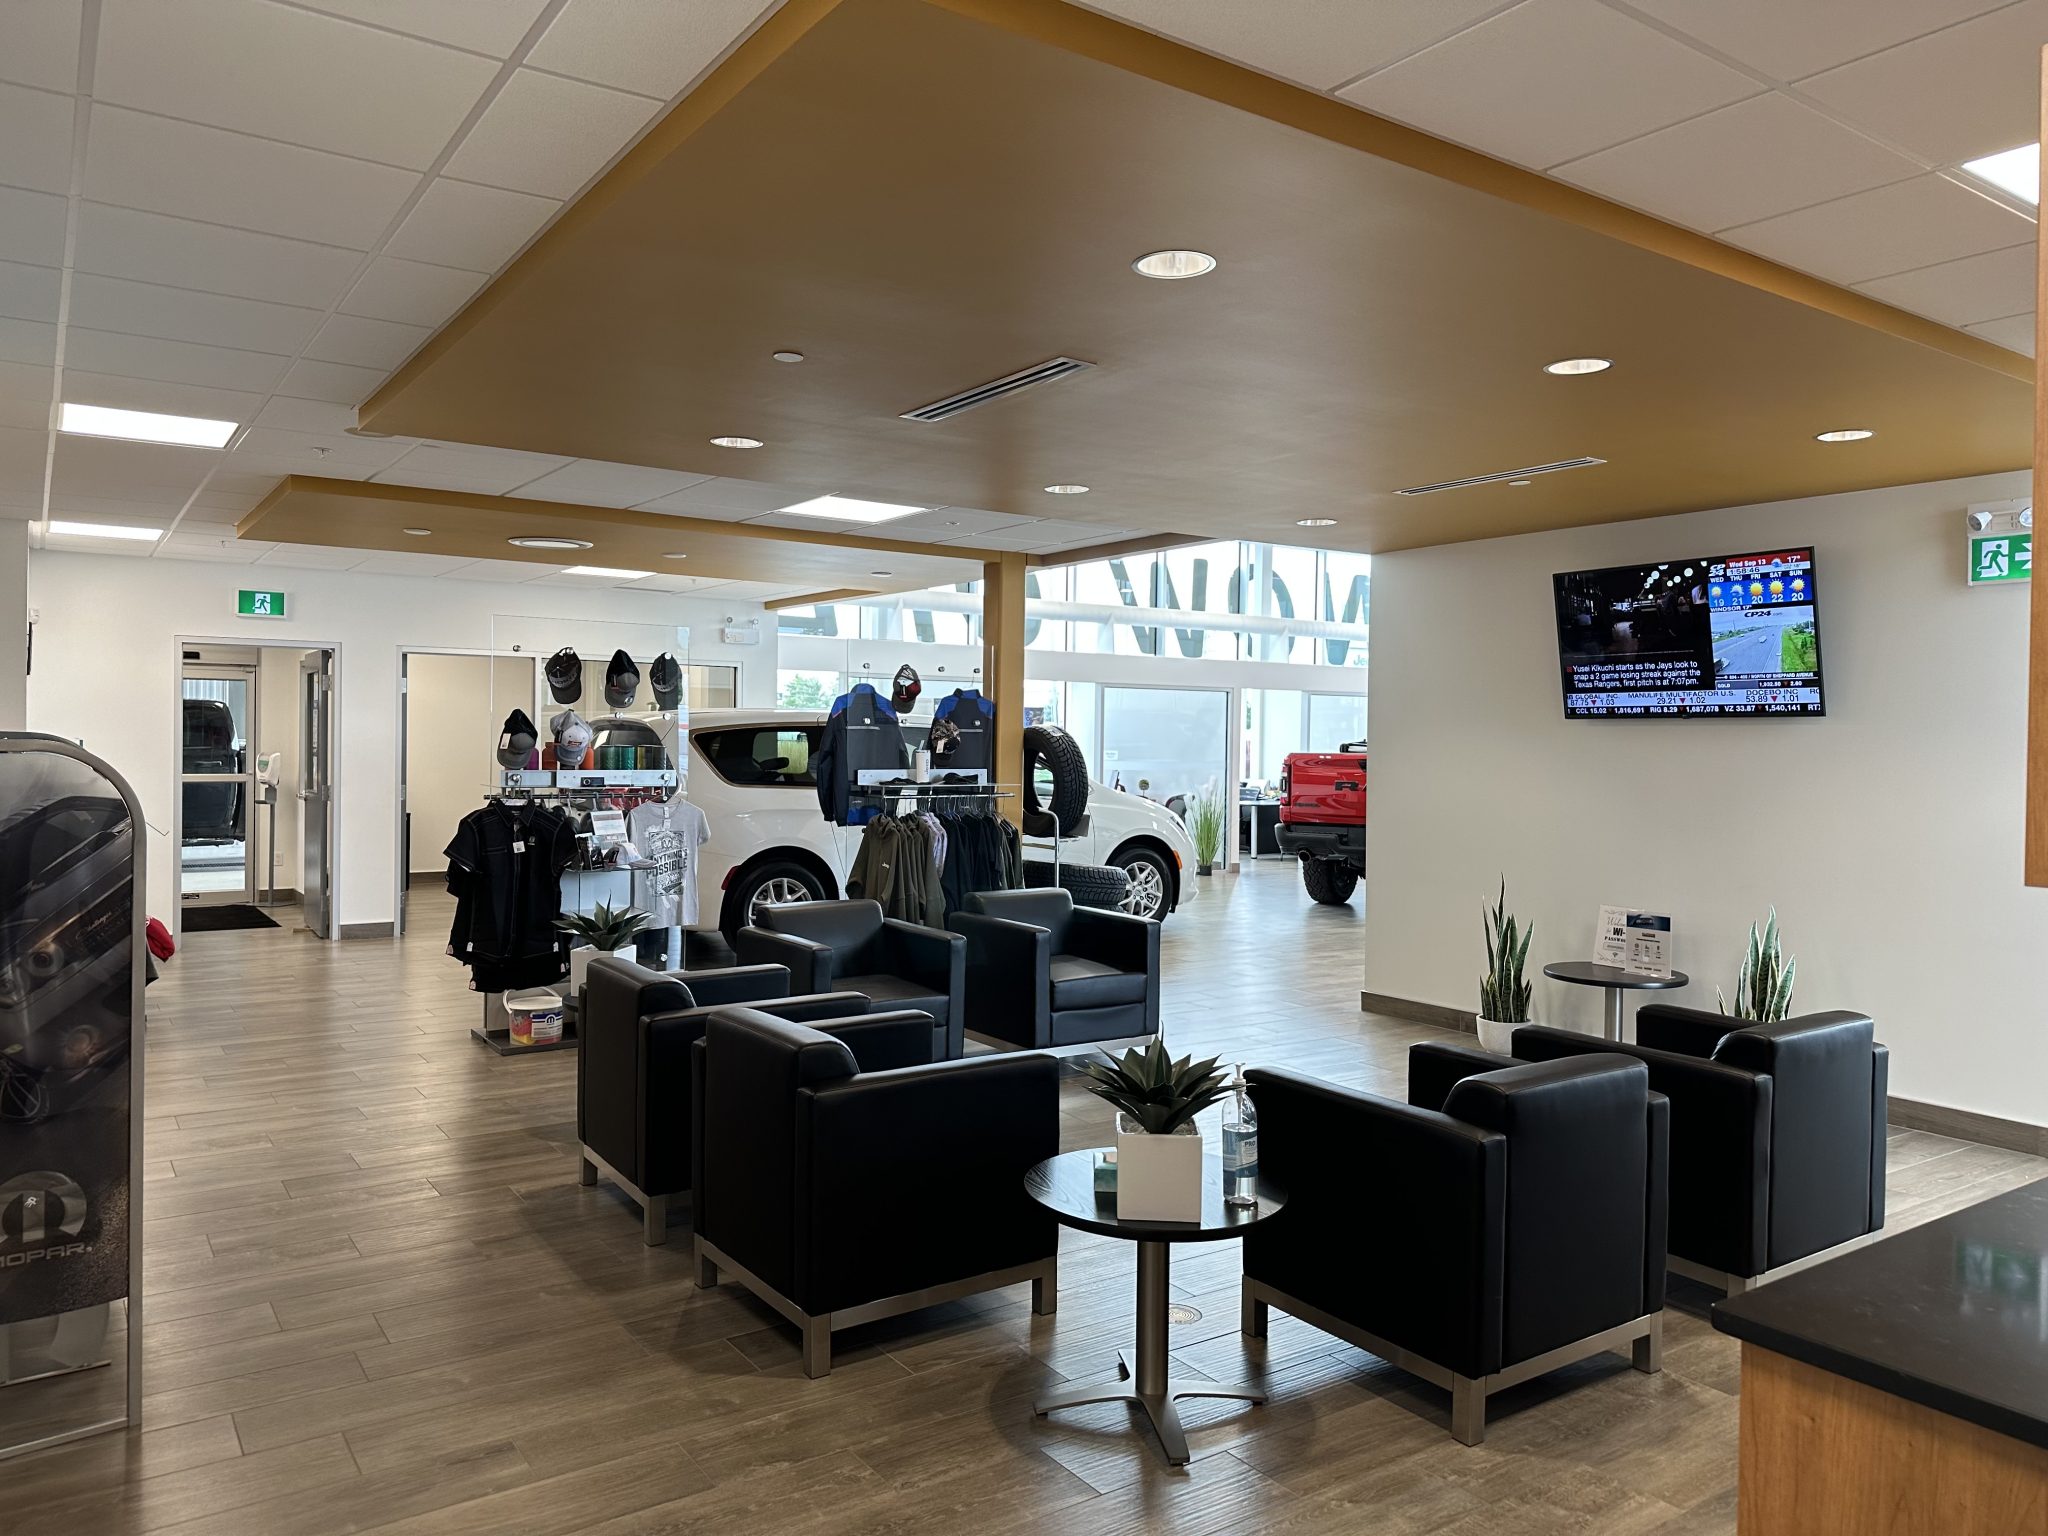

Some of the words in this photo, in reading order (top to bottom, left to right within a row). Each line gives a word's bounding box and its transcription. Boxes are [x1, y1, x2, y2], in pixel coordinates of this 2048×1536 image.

[1751, 596, 1763, 604] 20
[1771, 594, 1784, 602] 22
[1791, 592, 1804, 601] 20
[1572, 665, 1590, 673] Yusei
[1591, 664, 1614, 672] Kikuchi
[1615, 663, 1633, 671] starts
[1644, 662, 1655, 670] the
[1656, 662, 1673, 671] Jays
[1573, 674, 1589, 682] snap
[1620, 671, 1640, 680] losing
[1641, 670, 1662, 678] streak
[1662, 669, 1687, 679] against
[1593, 680, 1622, 689] Rangers,
[1623, 679, 1636, 687] first
[1637, 678, 1654, 687] pitch
[1670, 677, 1699, 687] 7:07pm.
[1665, 690, 1719, 698] MULTIFACTOR
[1765, 704, 1801, 712] 1,540,141
[646, 857, 688, 880] POSSIBLE
[0, 1240, 86, 1268] OPAR
